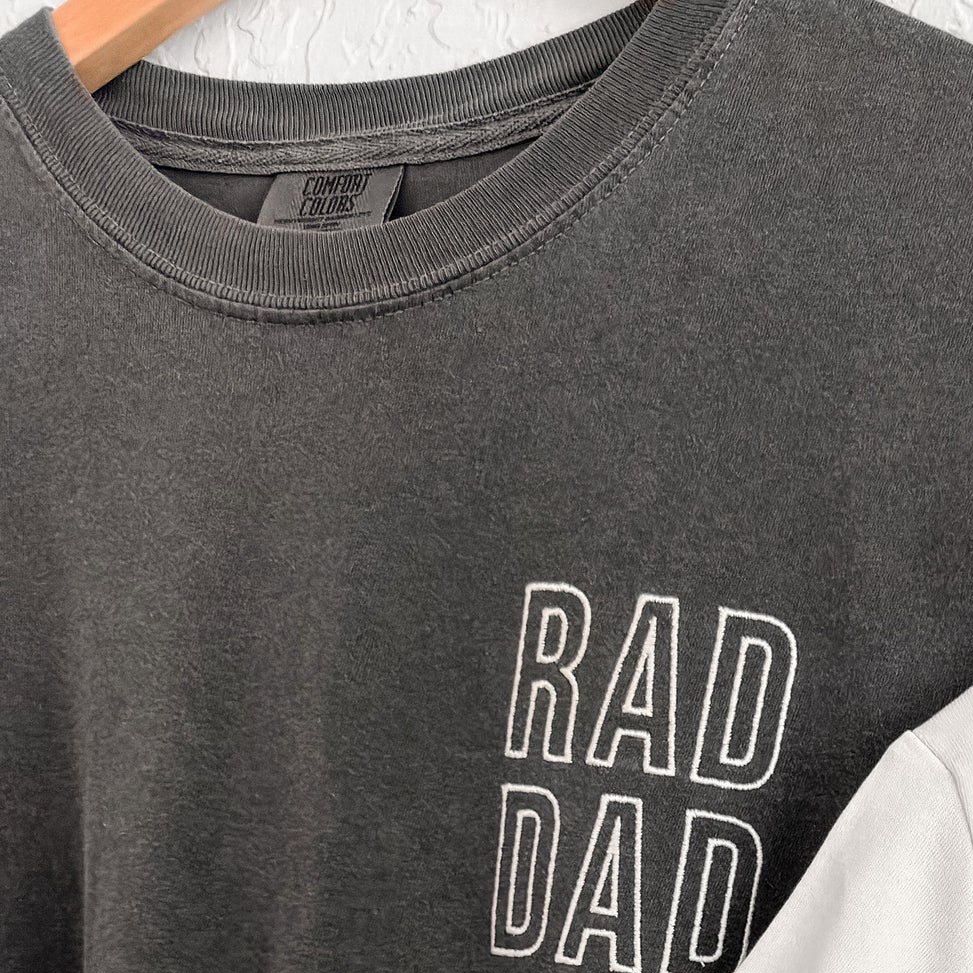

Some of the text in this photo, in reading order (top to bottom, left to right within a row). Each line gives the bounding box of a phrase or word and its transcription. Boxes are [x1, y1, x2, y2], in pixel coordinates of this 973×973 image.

[302, 173, 373, 196] COMFORT
[299, 195, 357, 216] COLORS
[504, 581, 798, 791] RAD
